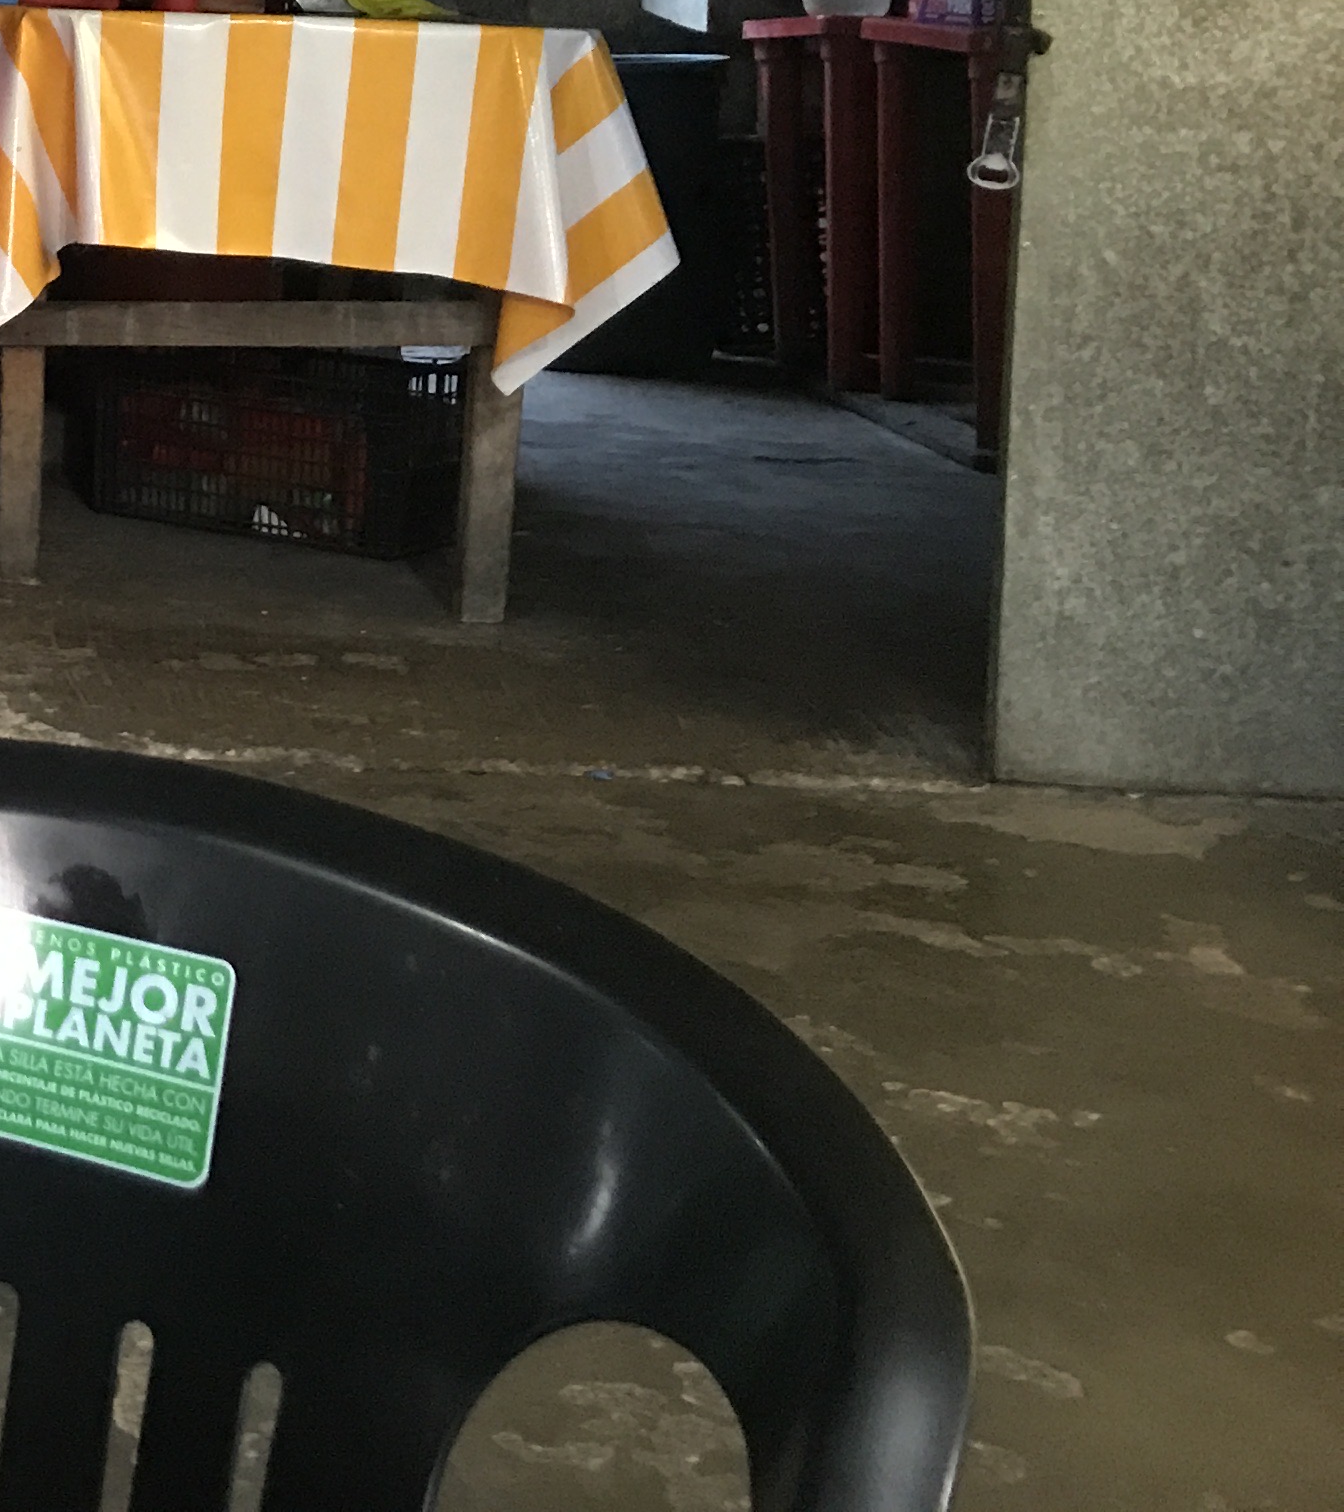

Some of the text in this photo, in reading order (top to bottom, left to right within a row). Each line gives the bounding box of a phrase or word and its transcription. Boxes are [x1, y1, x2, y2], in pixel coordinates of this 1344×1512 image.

[33, 929, 225, 986] ENOS PLÁSTICO
[18, 944, 217, 1037] MEJOR
[3, 989, 210, 1079] PLANETA
[9, 1048, 48, 1074] SILLA
[98, 1073, 158, 1102] HECHA
[162, 1089, 206, 1115] CON
[35, 1096, 100, 1127] TERMINE
[102, 1115, 124, 1134] SU
[129, 1123, 163, 1144] VIDA
[69, 1128, 107, 1147] HACER
